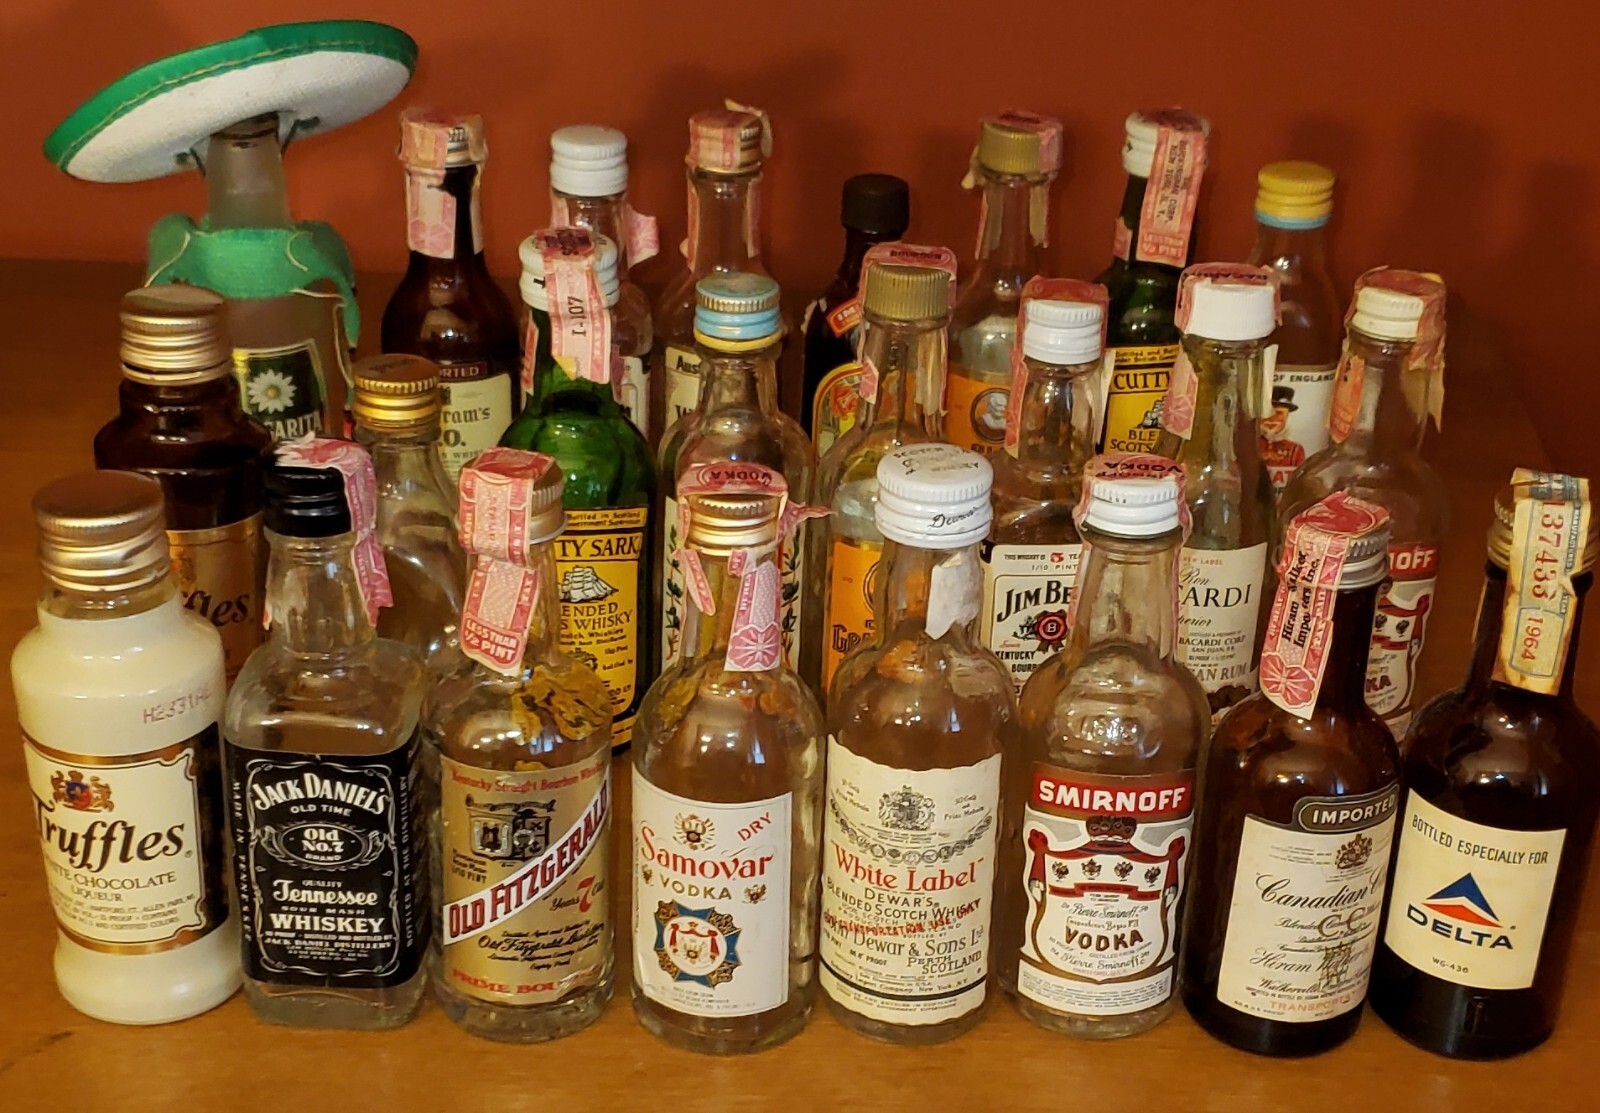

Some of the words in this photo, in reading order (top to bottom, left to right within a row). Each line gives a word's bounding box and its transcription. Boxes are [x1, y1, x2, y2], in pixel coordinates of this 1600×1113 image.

[567, 296, 587, 337] I-107
[1290, 374, 1335, 382] ENGLAND
[442, 407, 491, 424] ram's
[1128, 429, 1157, 441] BLE
[1103, 461, 1183, 474] VODKA
[589, 536, 640, 557] SARK
[1307, 558, 1321, 583] Inc.
[997, 587, 1042, 623] JIM
[1044, 580, 1073, 604] BE
[1179, 583, 1252, 608] ARDI
[562, 602, 618, 617] ENDED
[574, 609, 633, 630] WHISKY
[1282, 601, 1299, 642] Hiram
[467, 619, 490, 637] LESS
[489, 627, 518, 649] THAN
[1047, 623, 1056, 633] B
[1520, 616, 1544, 661] 1964
[481, 642, 516, 661] PINT
[1179, 637, 1221, 646] BACARDI
[1220, 662, 1247, 681] RUM
[252, 779, 304, 810] JACK
[303, 772, 390, 815] DANIEL'S
[1038, 780, 1186, 813] SMIRNOFF
[290, 804, 317, 814] OLD
[321, 803, 353, 817] TIME
[1312, 794, 1396, 825] IMPORTED
[235, 828, 246, 844] IN
[304, 828, 339, 842] Old
[737, 812, 773, 842] DRY
[1411, 814, 1453, 848] BOTTLED
[1457, 840, 1525, 864] ESPECIALLY
[1528, 851, 1549, 865] FOR
[448, 898, 486, 939] OLD
[489, 779, 609, 923] FITZGERALD
[640, 825, 774, 880] Samovar
[833, 840, 898, 890] White
[74, 871, 177, 890] CHOCOLATE
[273, 879, 379, 906] Tennessee
[302, 880, 343, 888] QUALITY
[659, 874, 732, 900] VODKA
[1255, 872, 1369, 910] Canadian
[71, 885, 124, 902] LIQUEUR
[238, 854, 253, 943] TENNESSEE
[576, 876, 596, 913] 7
[827, 878, 872, 913] BLENDED
[874, 904, 927, 921] SCOTCH
[864, 887, 934, 908] DEWAR'S
[269, 913, 385, 933] WHISKEY
[1406, 903, 1514, 951] DELTA
[478, 934, 502, 949] Old
[502, 937, 562, 957] Fitzgerald
[853, 932, 906, 956] Dewar
[908, 943, 921, 957] &
[925, 938, 967, 956] Sons
[1065, 925, 1144, 952] VODKA
[907, 953, 952, 968] PERTH
[922, 950, 982, 976] SCOTLAND
[1061, 952, 1094, 969] Pierre
[1097, 955, 1140, 970] Smirnoff
[1249, 947, 1313, 973] Hiram
[452, 968, 511, 994] PRIME
